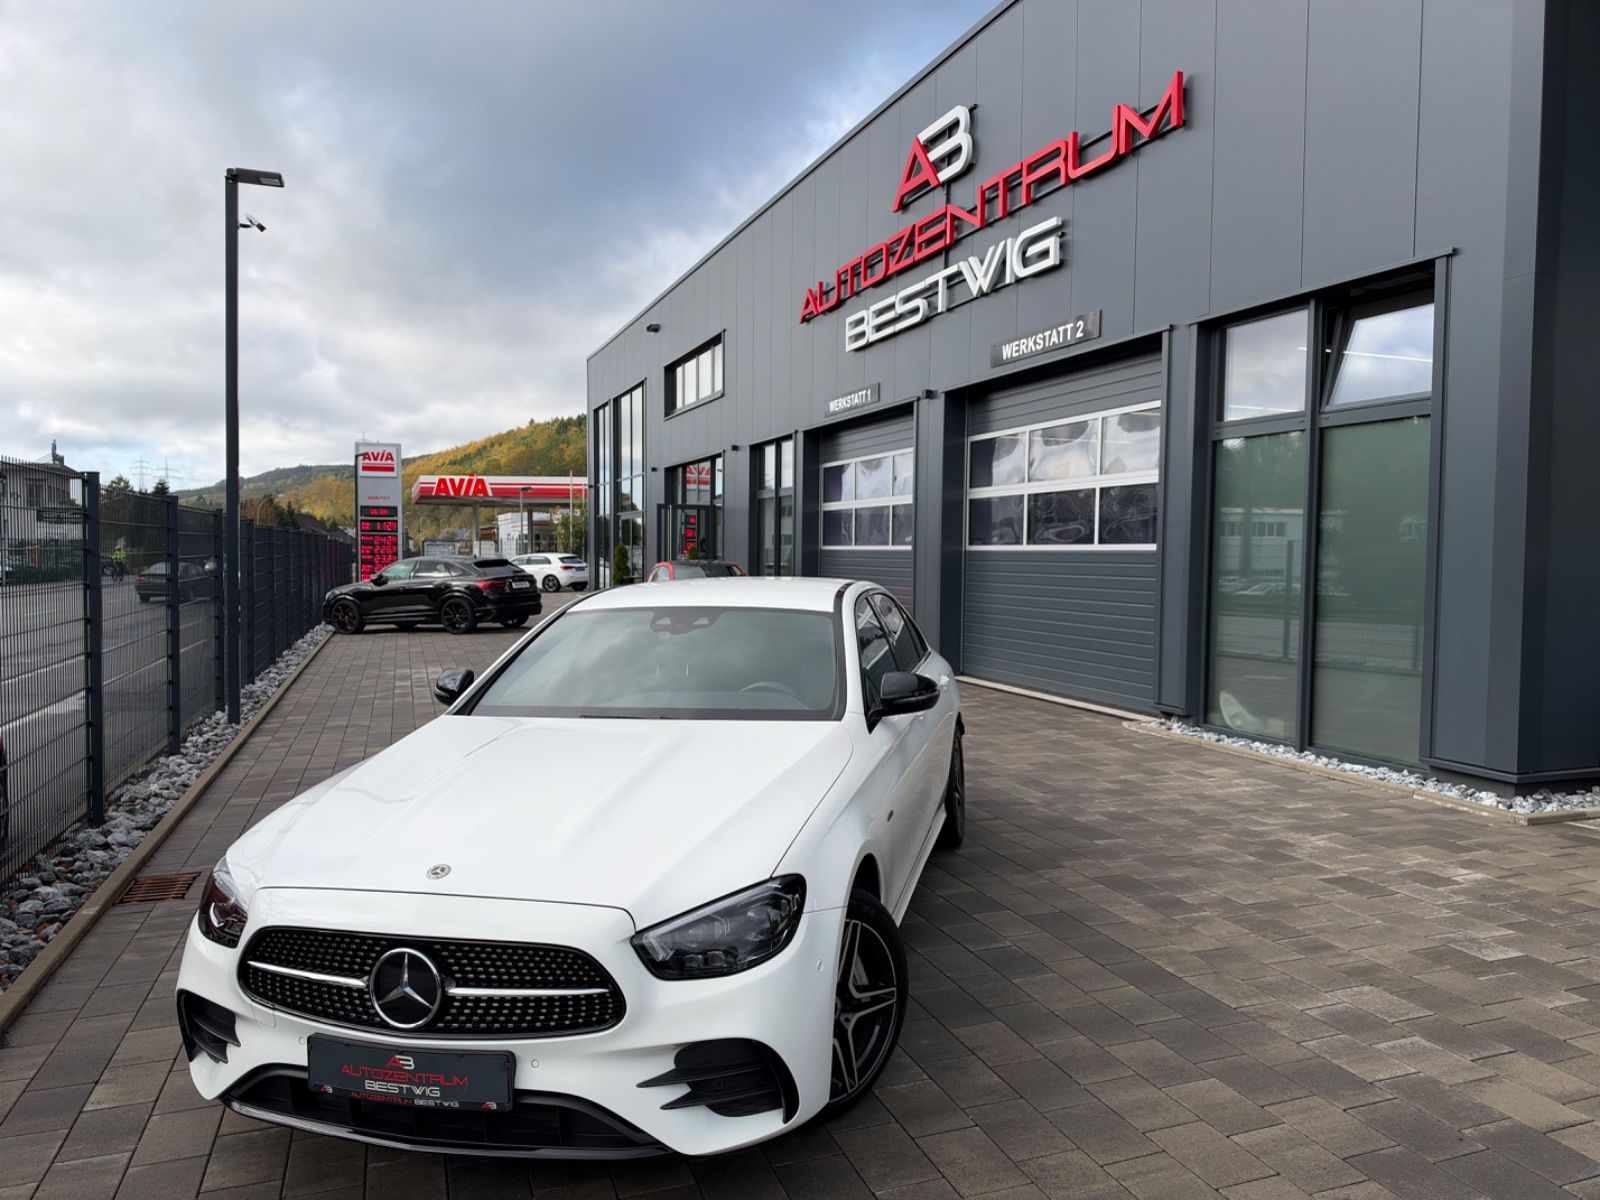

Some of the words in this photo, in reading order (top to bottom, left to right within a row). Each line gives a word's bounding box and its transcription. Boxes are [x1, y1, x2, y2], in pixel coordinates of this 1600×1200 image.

[800, 70, 1185, 324] AUTOZENTRUM
[845, 216, 1063, 353] BESTWIG
[1002, 324, 1072, 359] WERKSTATT
[1075, 320, 1085, 339] 2
[829, 390, 867, 412] WERKSTATT
[361, 449, 394, 462] AVIA
[433, 473, 490, 496] AVIA
[340, 1064, 470, 1087] AUTOZENTRUM
[351, 1091, 413, 1105] AUTOZENTRUM
[413, 1099, 460, 1108] BESTWIG
[364, 1080, 441, 1097] BESTWIG
